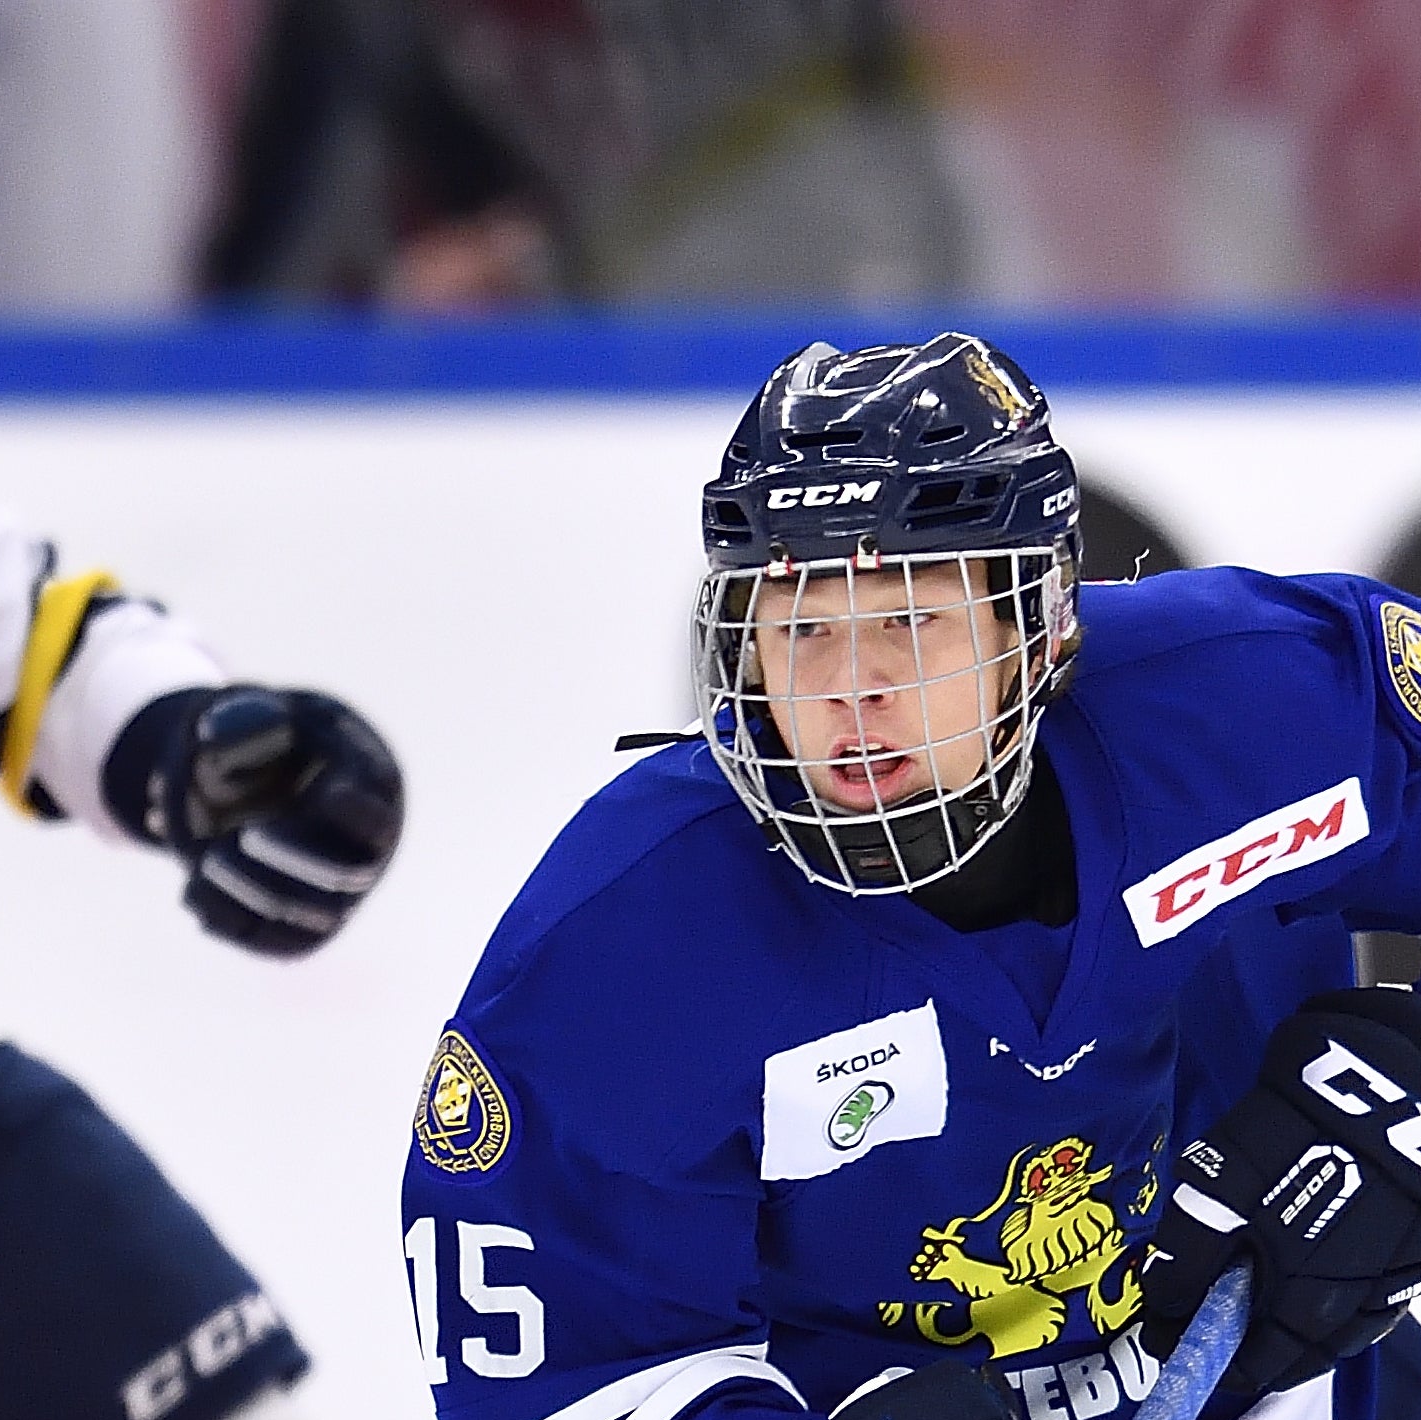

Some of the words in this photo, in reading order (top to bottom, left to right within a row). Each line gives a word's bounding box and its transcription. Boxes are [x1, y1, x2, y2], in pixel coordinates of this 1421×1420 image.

[767, 481, 881, 511] CCM
[1151, 797, 1347, 923] CCM
[816, 1042, 901, 1084] ŠKODA
[405, 1217, 546, 1385] 15
